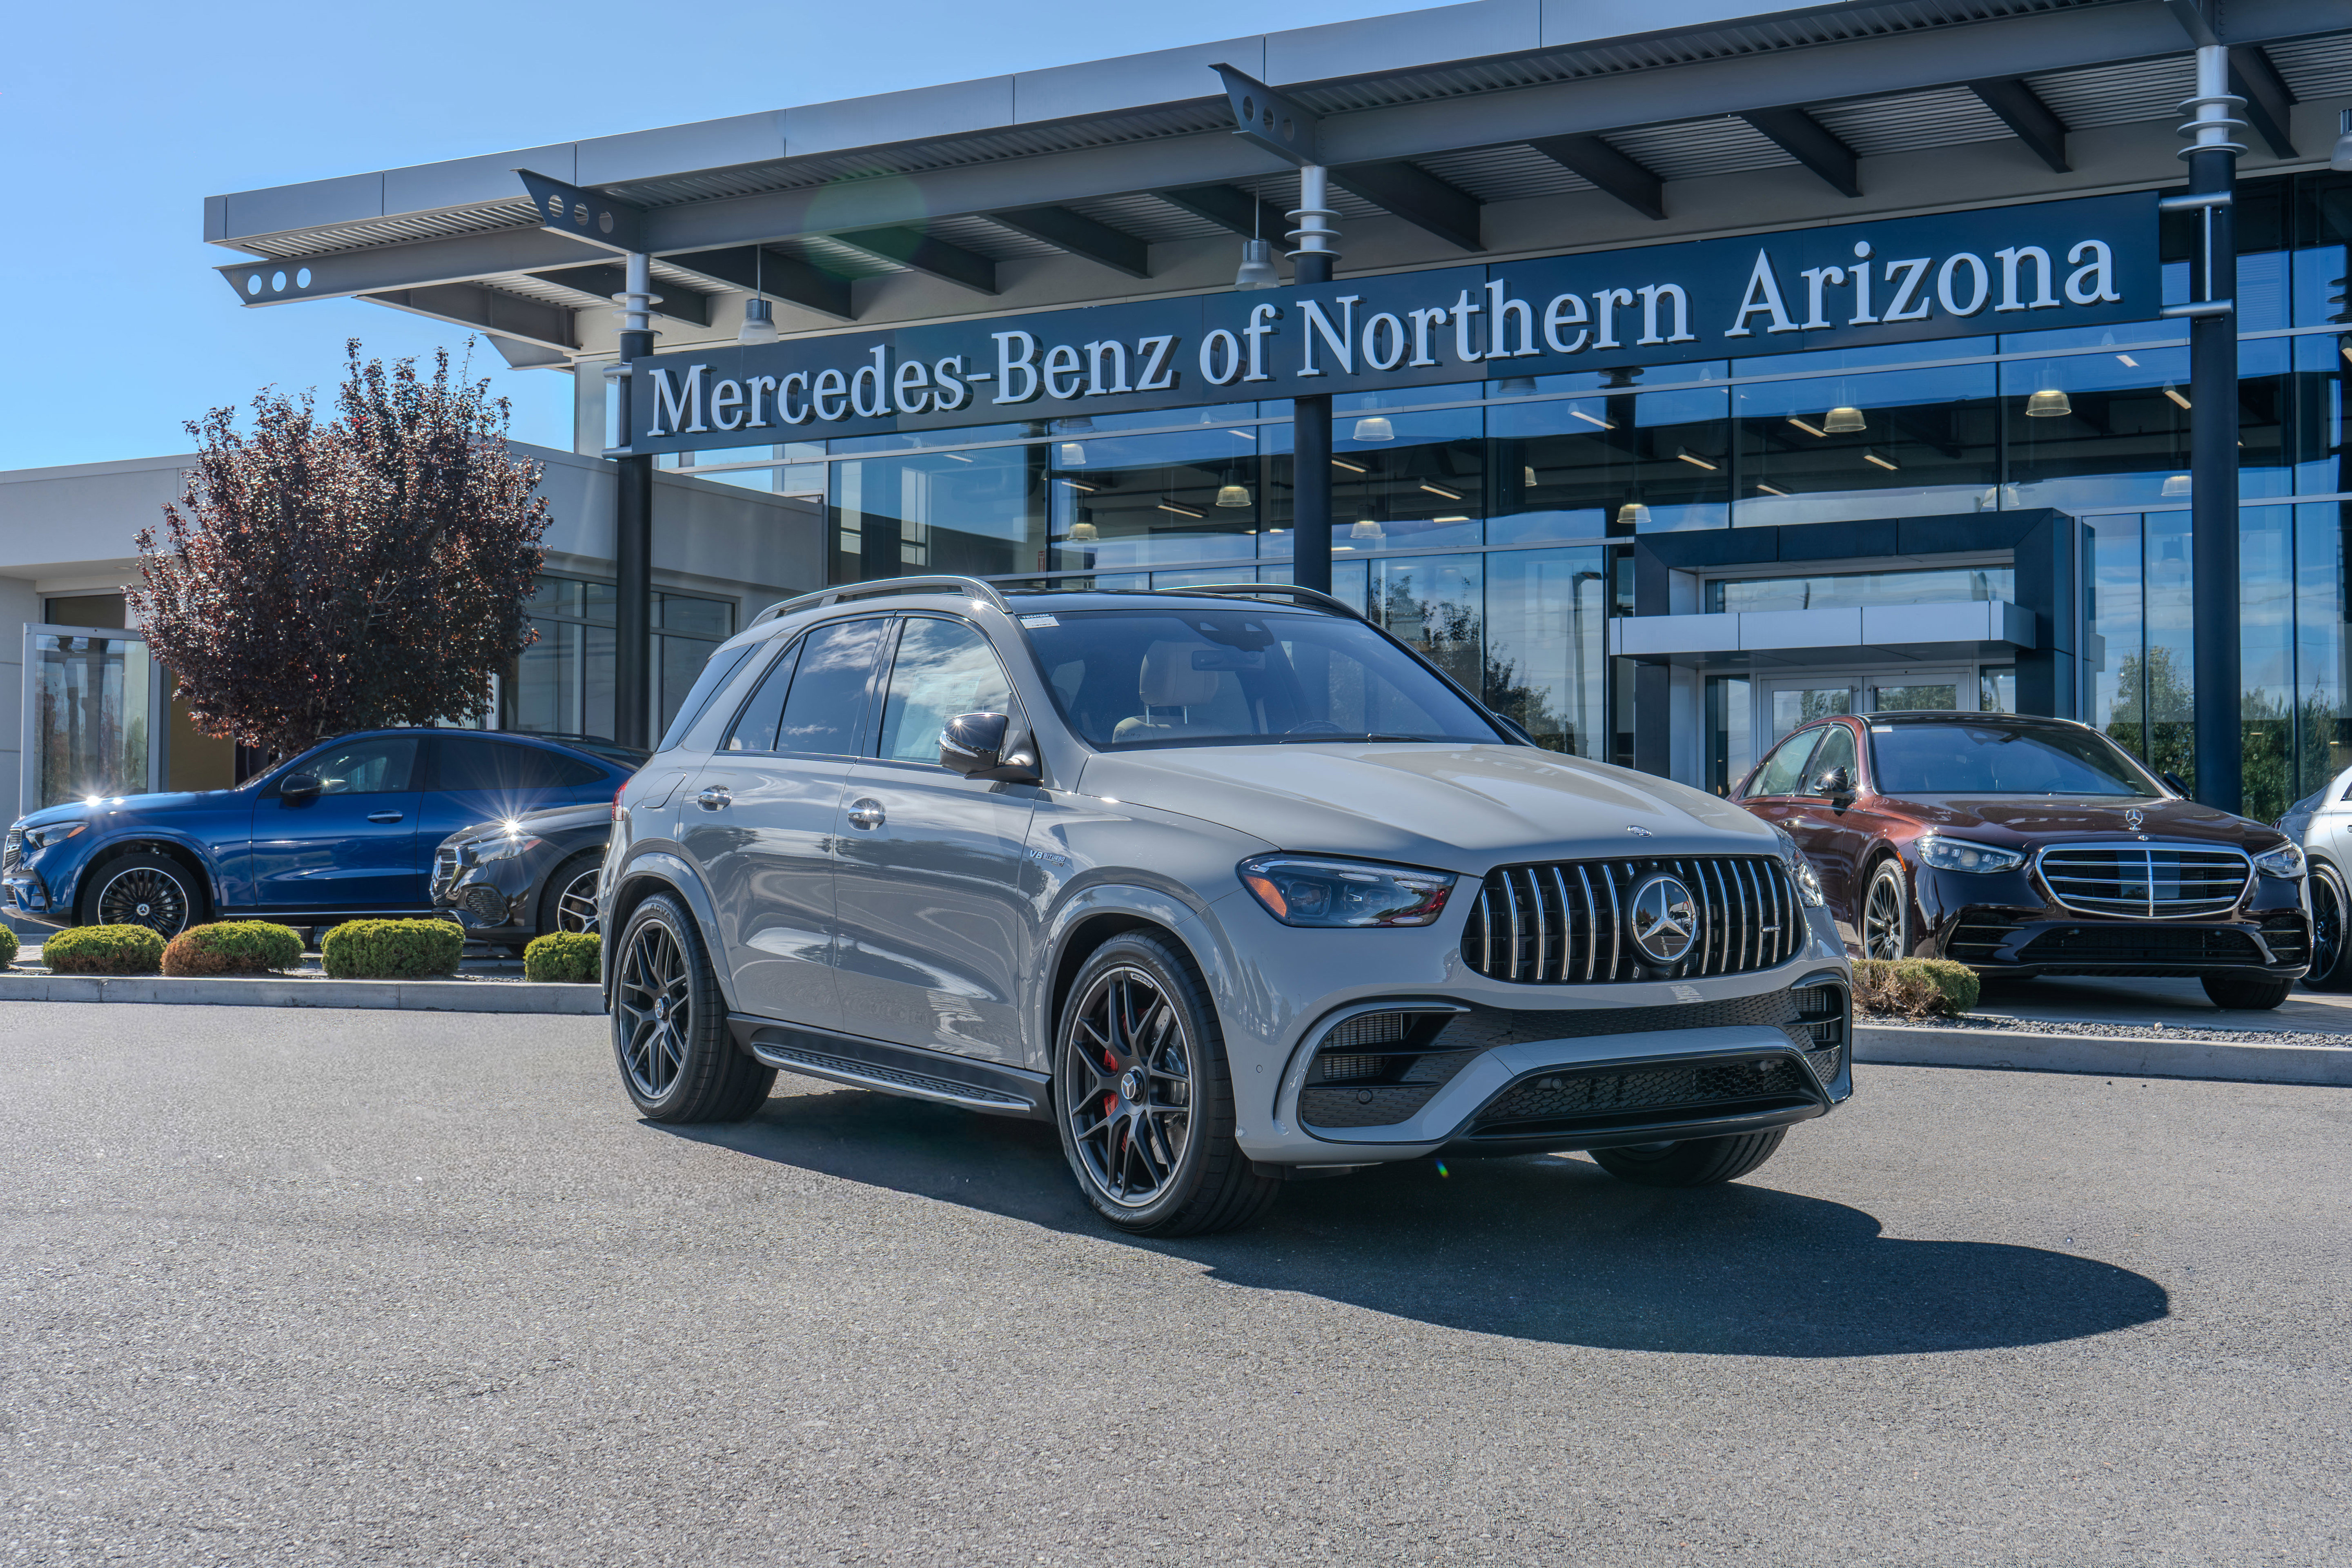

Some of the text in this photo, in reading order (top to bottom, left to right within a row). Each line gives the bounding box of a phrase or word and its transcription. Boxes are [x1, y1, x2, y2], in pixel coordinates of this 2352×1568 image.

[647, 240, 2121, 438] Mercedes-Benz of Northern Arizona
[1029, 850, 1066, 862] V8 BITURBO
[650, 903, 677, 930] ADVAN
[1177, 994, 1197, 1051] YOKOHAMA
